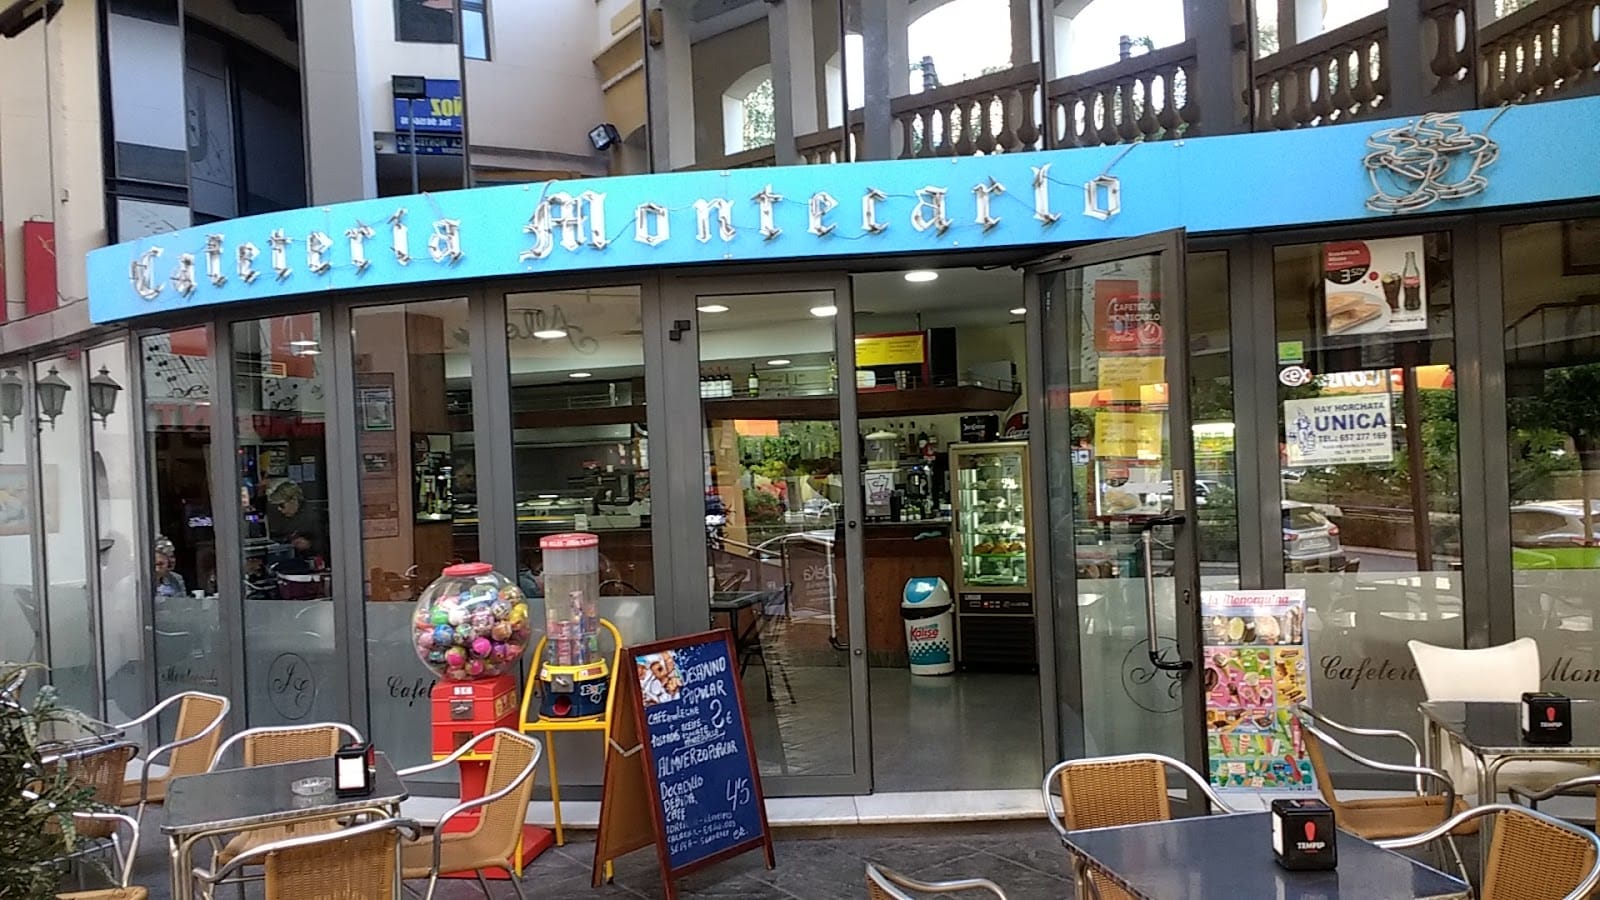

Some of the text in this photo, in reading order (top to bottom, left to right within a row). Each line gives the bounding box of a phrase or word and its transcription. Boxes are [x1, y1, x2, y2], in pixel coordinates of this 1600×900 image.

[130, 163, 1121, 301] Cafeteria Montecarlo
[1313, 404, 1332, 413] HAY
[1314, 412, 1386, 431] UNICA
